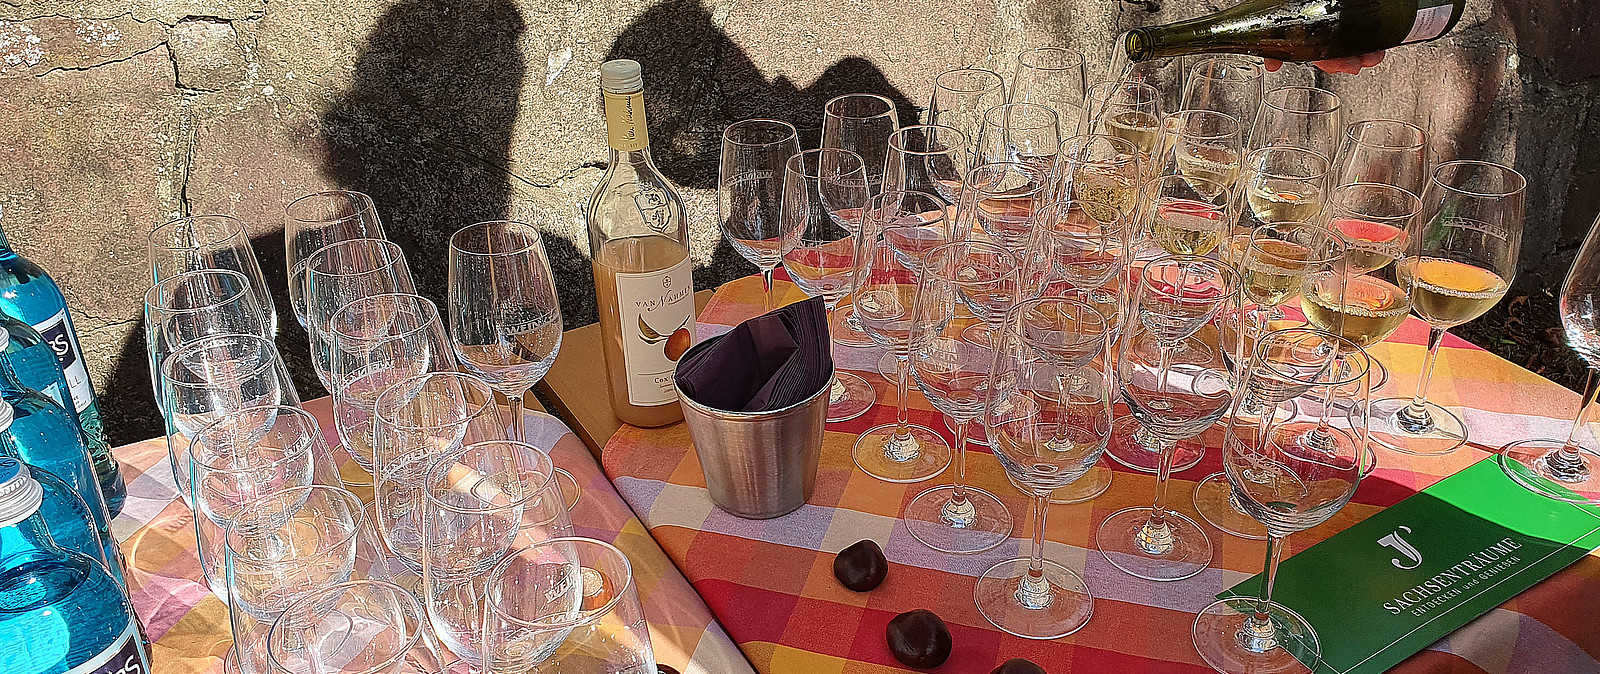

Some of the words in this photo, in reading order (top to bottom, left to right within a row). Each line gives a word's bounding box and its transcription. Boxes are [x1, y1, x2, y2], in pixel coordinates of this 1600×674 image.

[635, 299, 657, 308] VAN
[1383, 537, 1523, 615] SACHSENTRÄUME
[1411, 588, 1462, 617] ENTDECKEN
[1463, 578, 1480, 592] und
